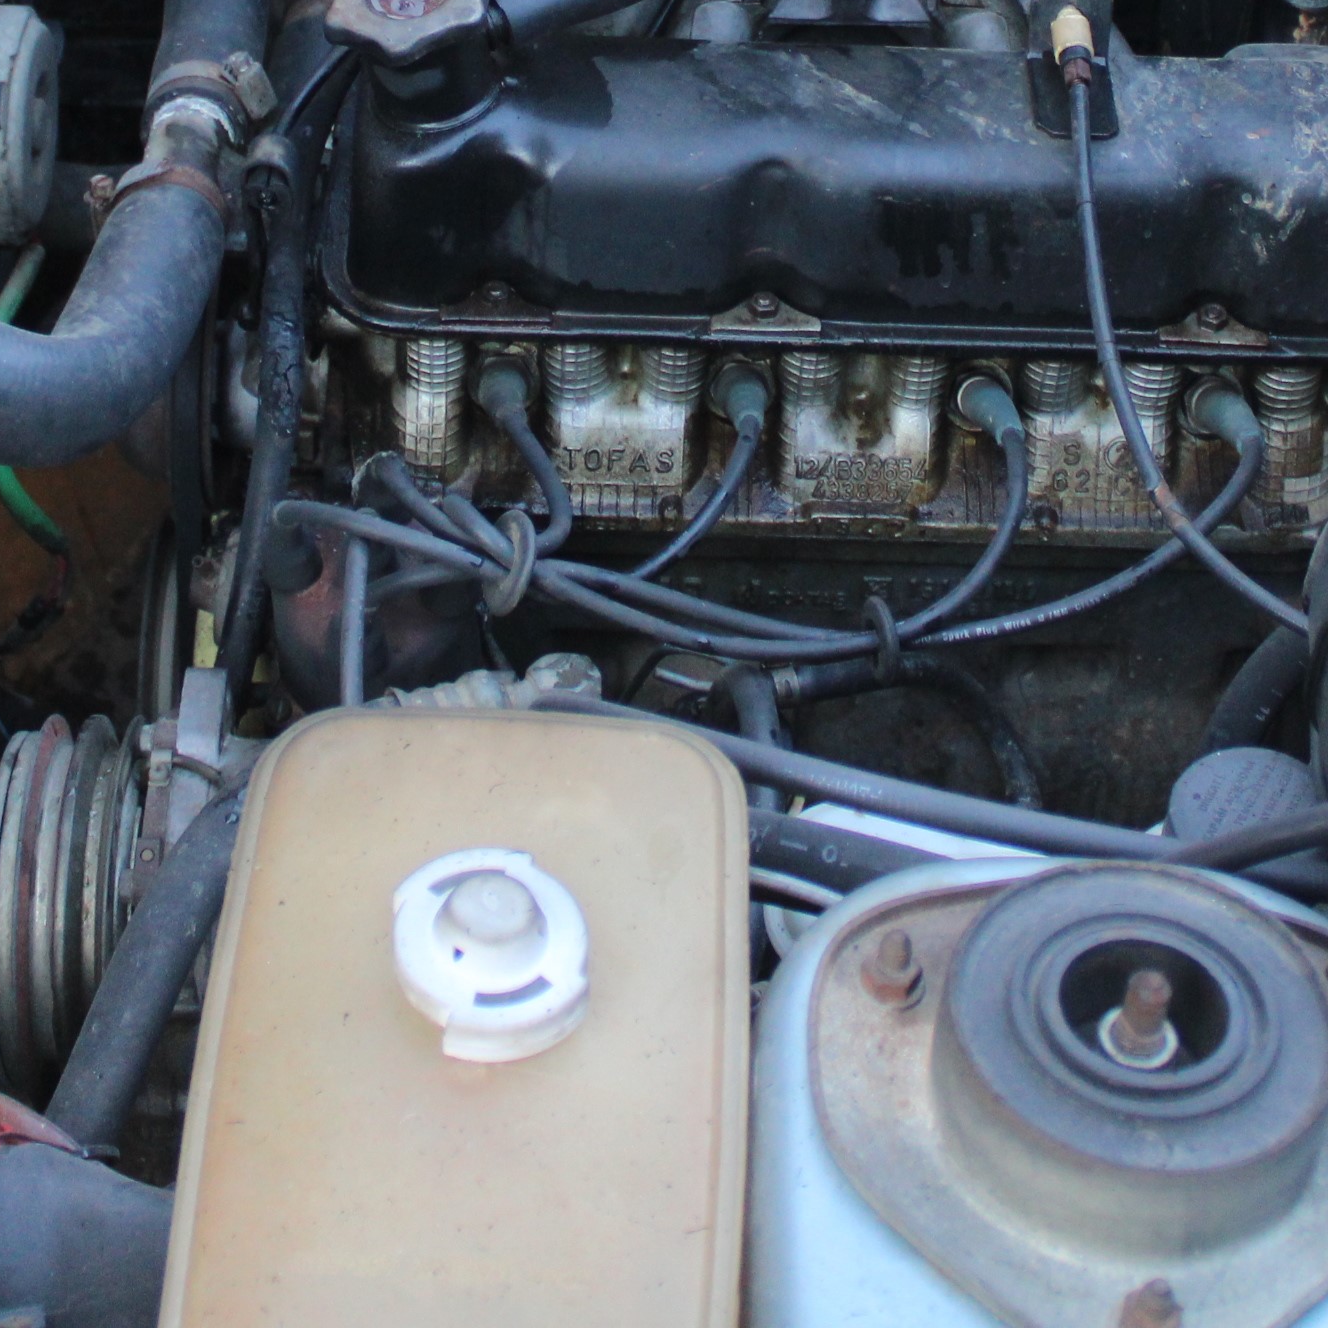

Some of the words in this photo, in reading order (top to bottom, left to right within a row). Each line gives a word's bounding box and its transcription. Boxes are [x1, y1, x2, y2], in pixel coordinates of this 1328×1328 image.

[563, 446, 675, 474] TOFAS
[942, 628, 970, 642] Spark
[975, 625, 999, 637] Plug
[1003, 617, 1032, 632] Wires
